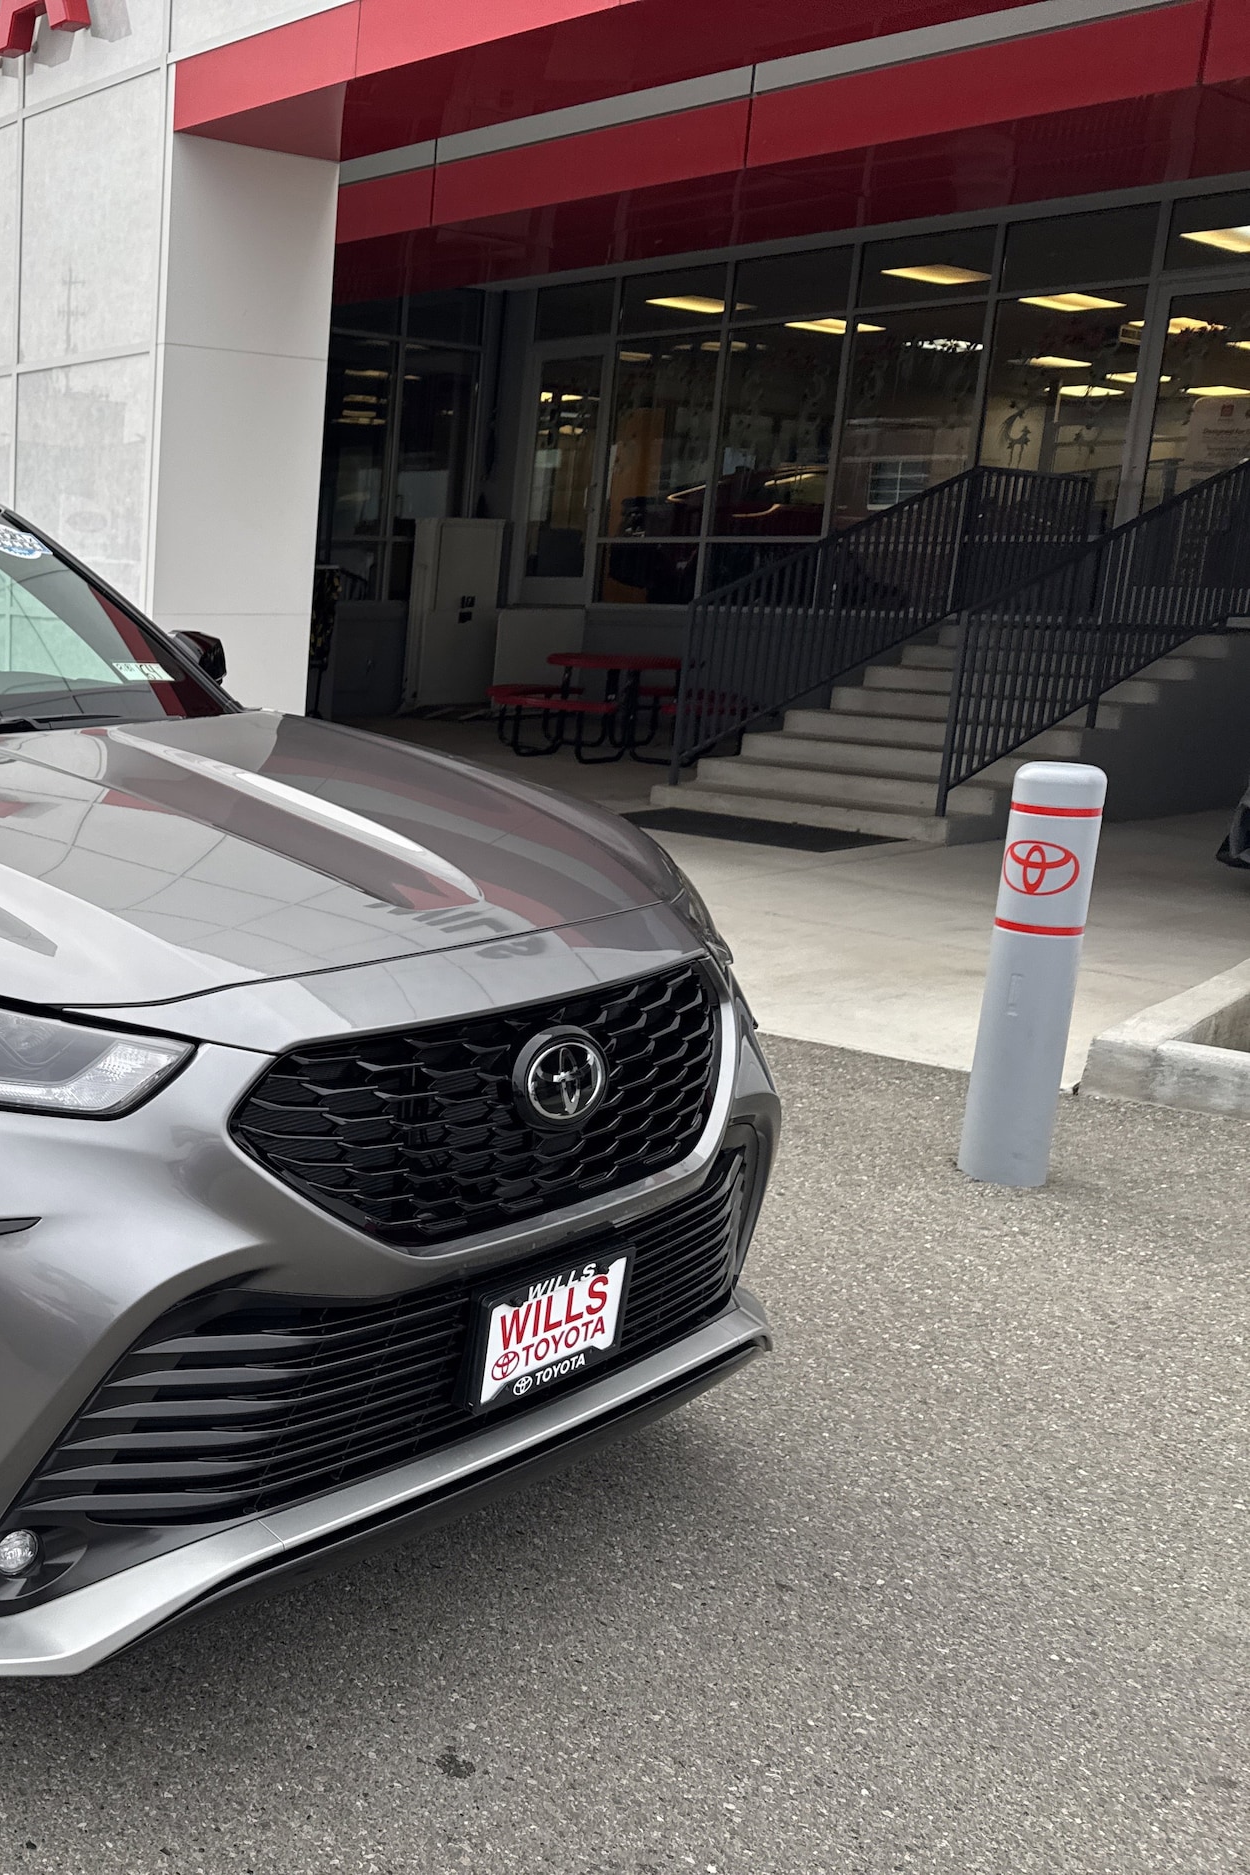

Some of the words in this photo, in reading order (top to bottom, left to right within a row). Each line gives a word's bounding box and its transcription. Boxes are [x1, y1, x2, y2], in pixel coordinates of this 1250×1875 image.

[528, 1263, 597, 1300] WILLS
[500, 1275, 609, 1350] WILLS
[522, 1316, 606, 1367] TOYOTA
[535, 1353, 586, 1385] TOYOTA
